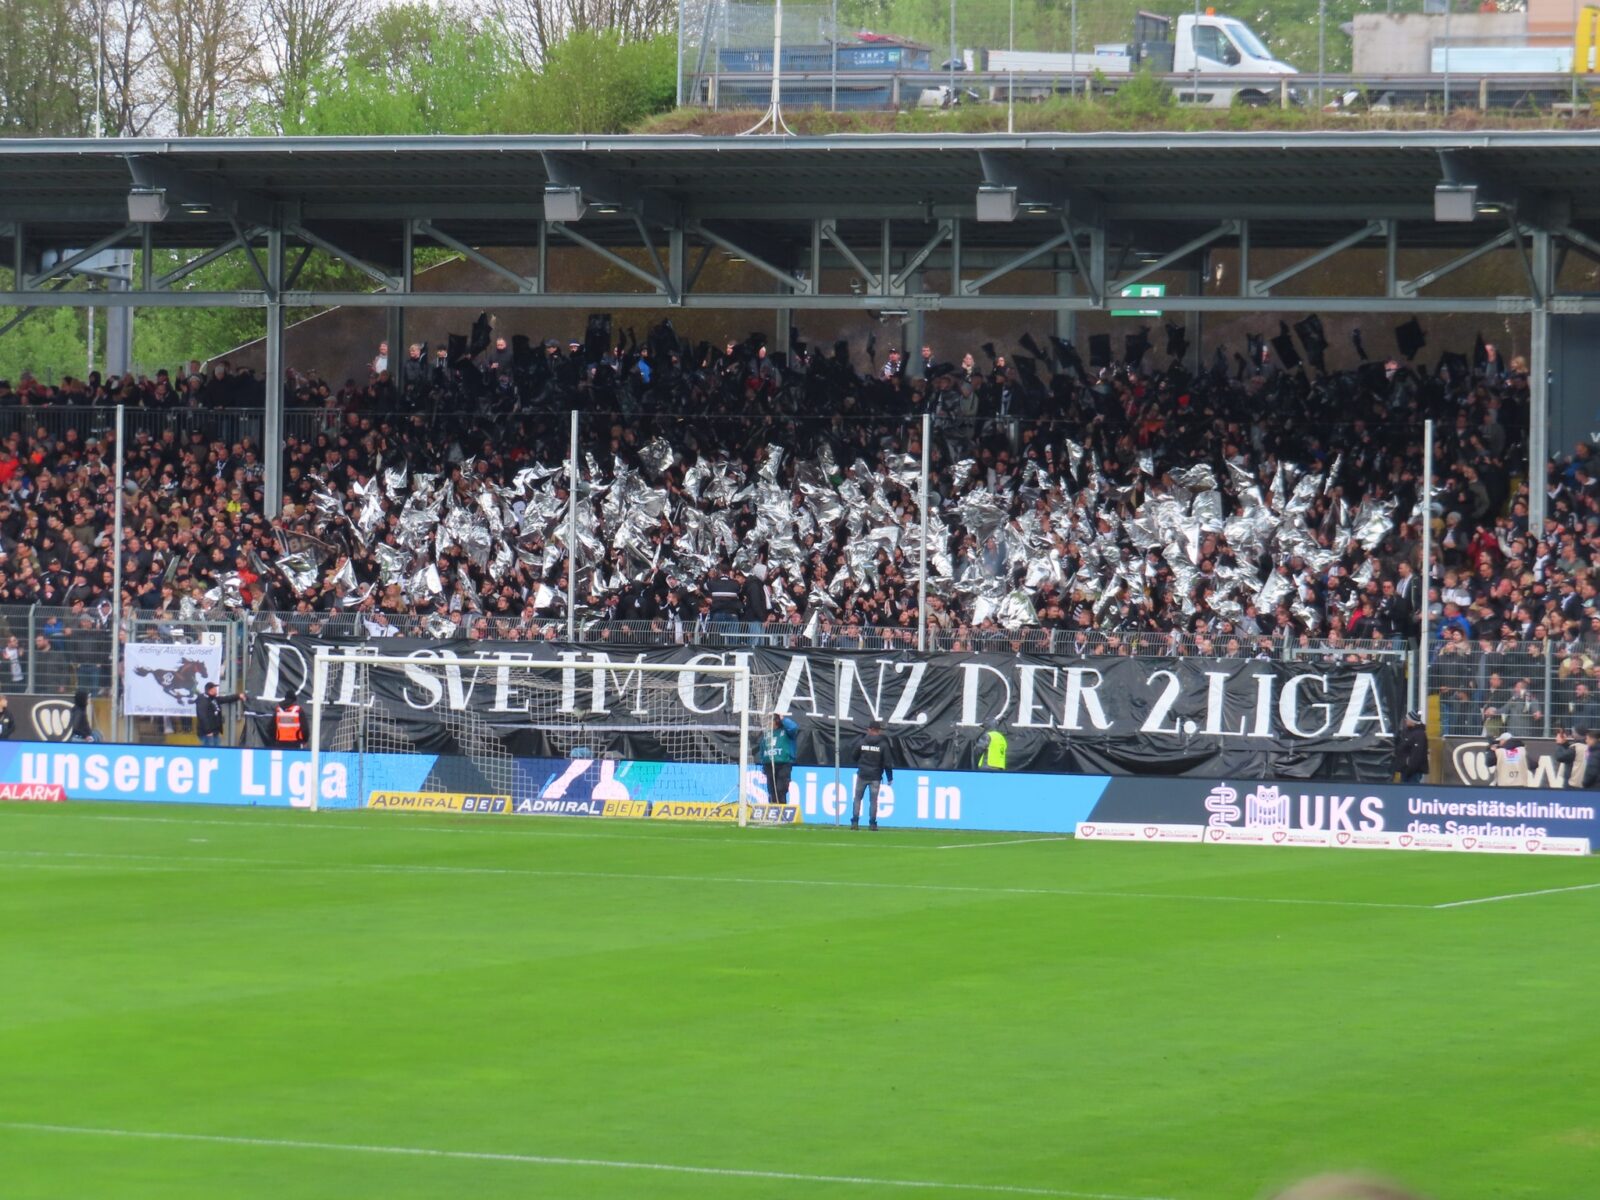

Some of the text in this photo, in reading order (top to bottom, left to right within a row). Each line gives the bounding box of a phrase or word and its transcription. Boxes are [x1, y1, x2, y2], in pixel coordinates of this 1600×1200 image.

[208, 633, 216, 646] 9
[256, 642, 379, 707] DIE
[555, 651, 650, 715] IM
[677, 653, 929, 726] GLANZ
[956, 662, 1115, 731] DER
[1141, 671, 1394, 739] 2.LIGA
[21, 749, 348, 807] unserer Liga
[1509, 770, 1519, 778] 07
[0, 784, 61, 802] ALARM
[917, 776, 961, 820] in
[373, 794, 505, 811] ADMIRAL BET
[517, 799, 645, 814] ADMIRAL BET
[1407, 798, 1595, 820] Universitätsklinikum
[657, 804, 794, 820] ADMIRA BET
[1300, 796, 1385, 833] UKS
[1407, 820, 1547, 837] des Saarlandes
